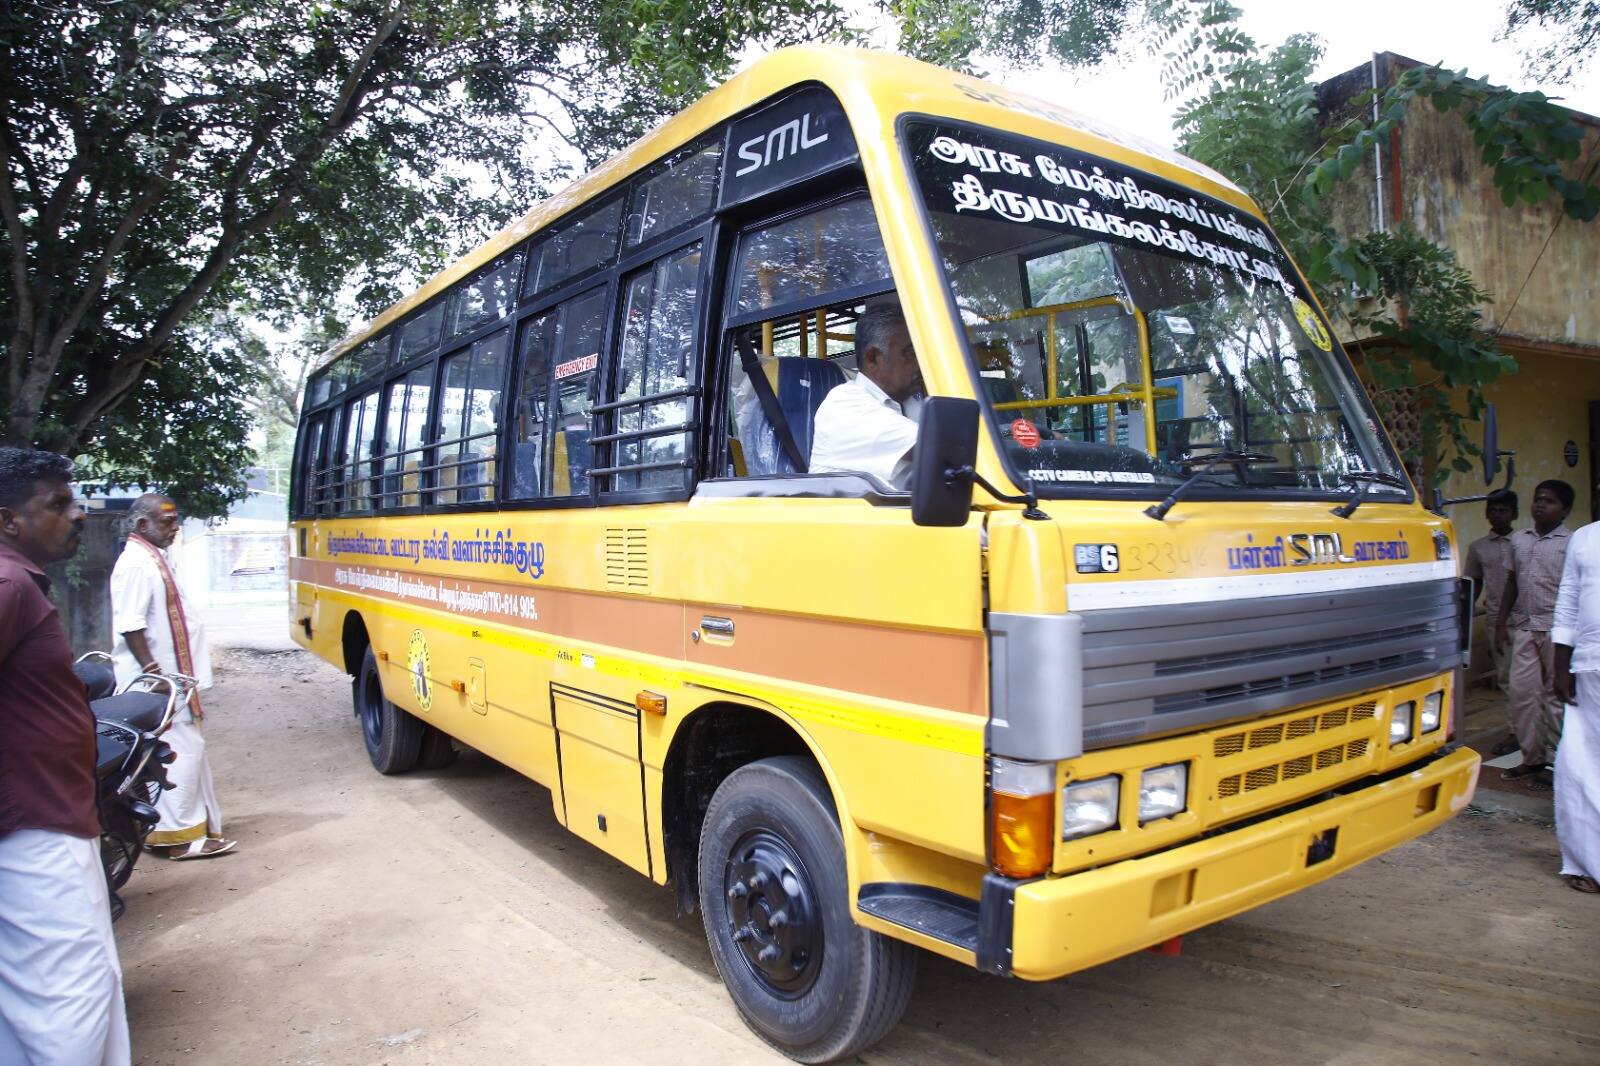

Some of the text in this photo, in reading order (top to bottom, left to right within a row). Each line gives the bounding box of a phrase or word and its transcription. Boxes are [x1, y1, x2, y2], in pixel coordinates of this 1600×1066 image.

[736, 113, 828, 177] SML
[929, 136, 1032, 178] அரசு
[556, 357, 586, 379] EMERGENCY
[1028, 469, 1056, 482] CCTV
[391, 536, 420, 565] வட்டார
[423, 528, 450, 560] கல்வி
[452, 528, 544, 579] வளர்ச்சிக்குழு
[1228, 533, 1287, 570] பள்ளி
[1288, 533, 1356, 566] SML
[1354, 530, 1409, 562] வாகனம்
